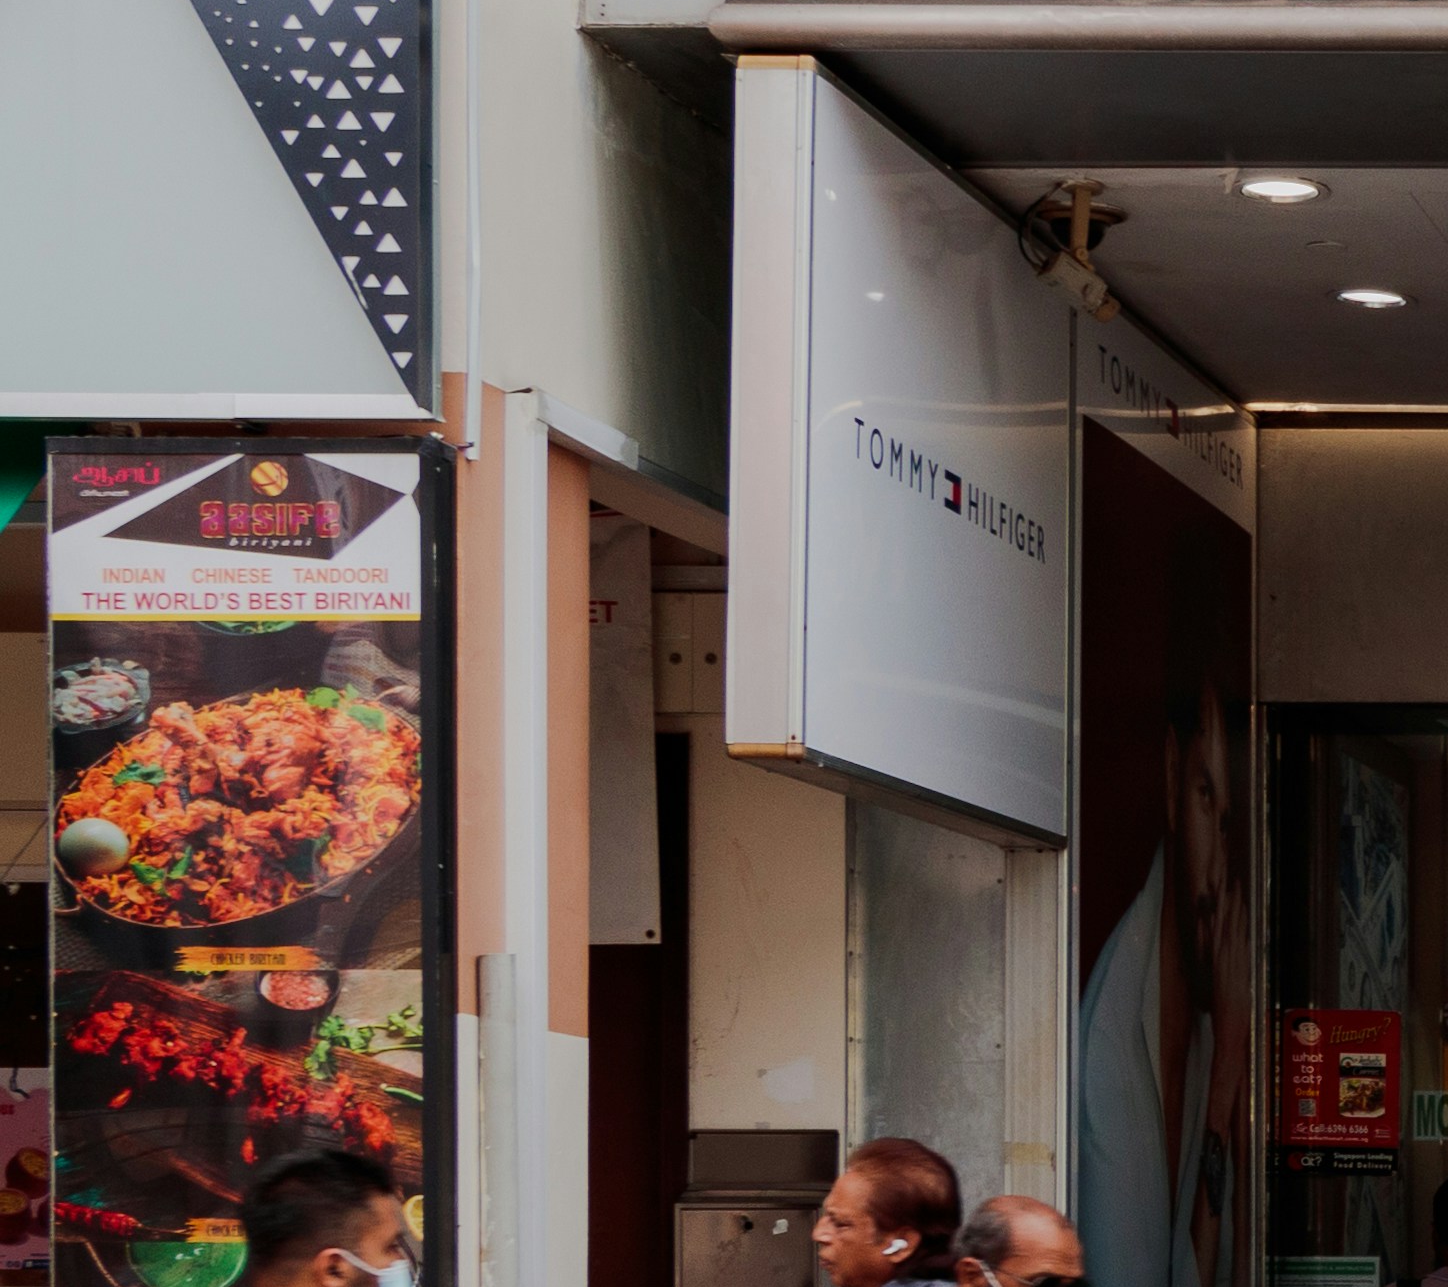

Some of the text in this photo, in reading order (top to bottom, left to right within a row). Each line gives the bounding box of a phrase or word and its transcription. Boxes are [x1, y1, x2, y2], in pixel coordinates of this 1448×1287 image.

[1100, 345, 1244, 491] TOMMY HILFIGER
[854, 416, 1046, 565] TOMMY HILFIGER
[229, 537, 313, 550] biriyani
[103, 568, 389, 584] INDIAN CHINESE TANDOORI
[82, 592, 411, 611] THE WORLD'S BEST BIRIYANI
[1329, 1017, 1392, 1046] Hungry?
[1291, 1053, 1324, 1063] what
[1300, 1064, 1315, 1074] to
[1292, 1074, 1323, 1085] eat?
